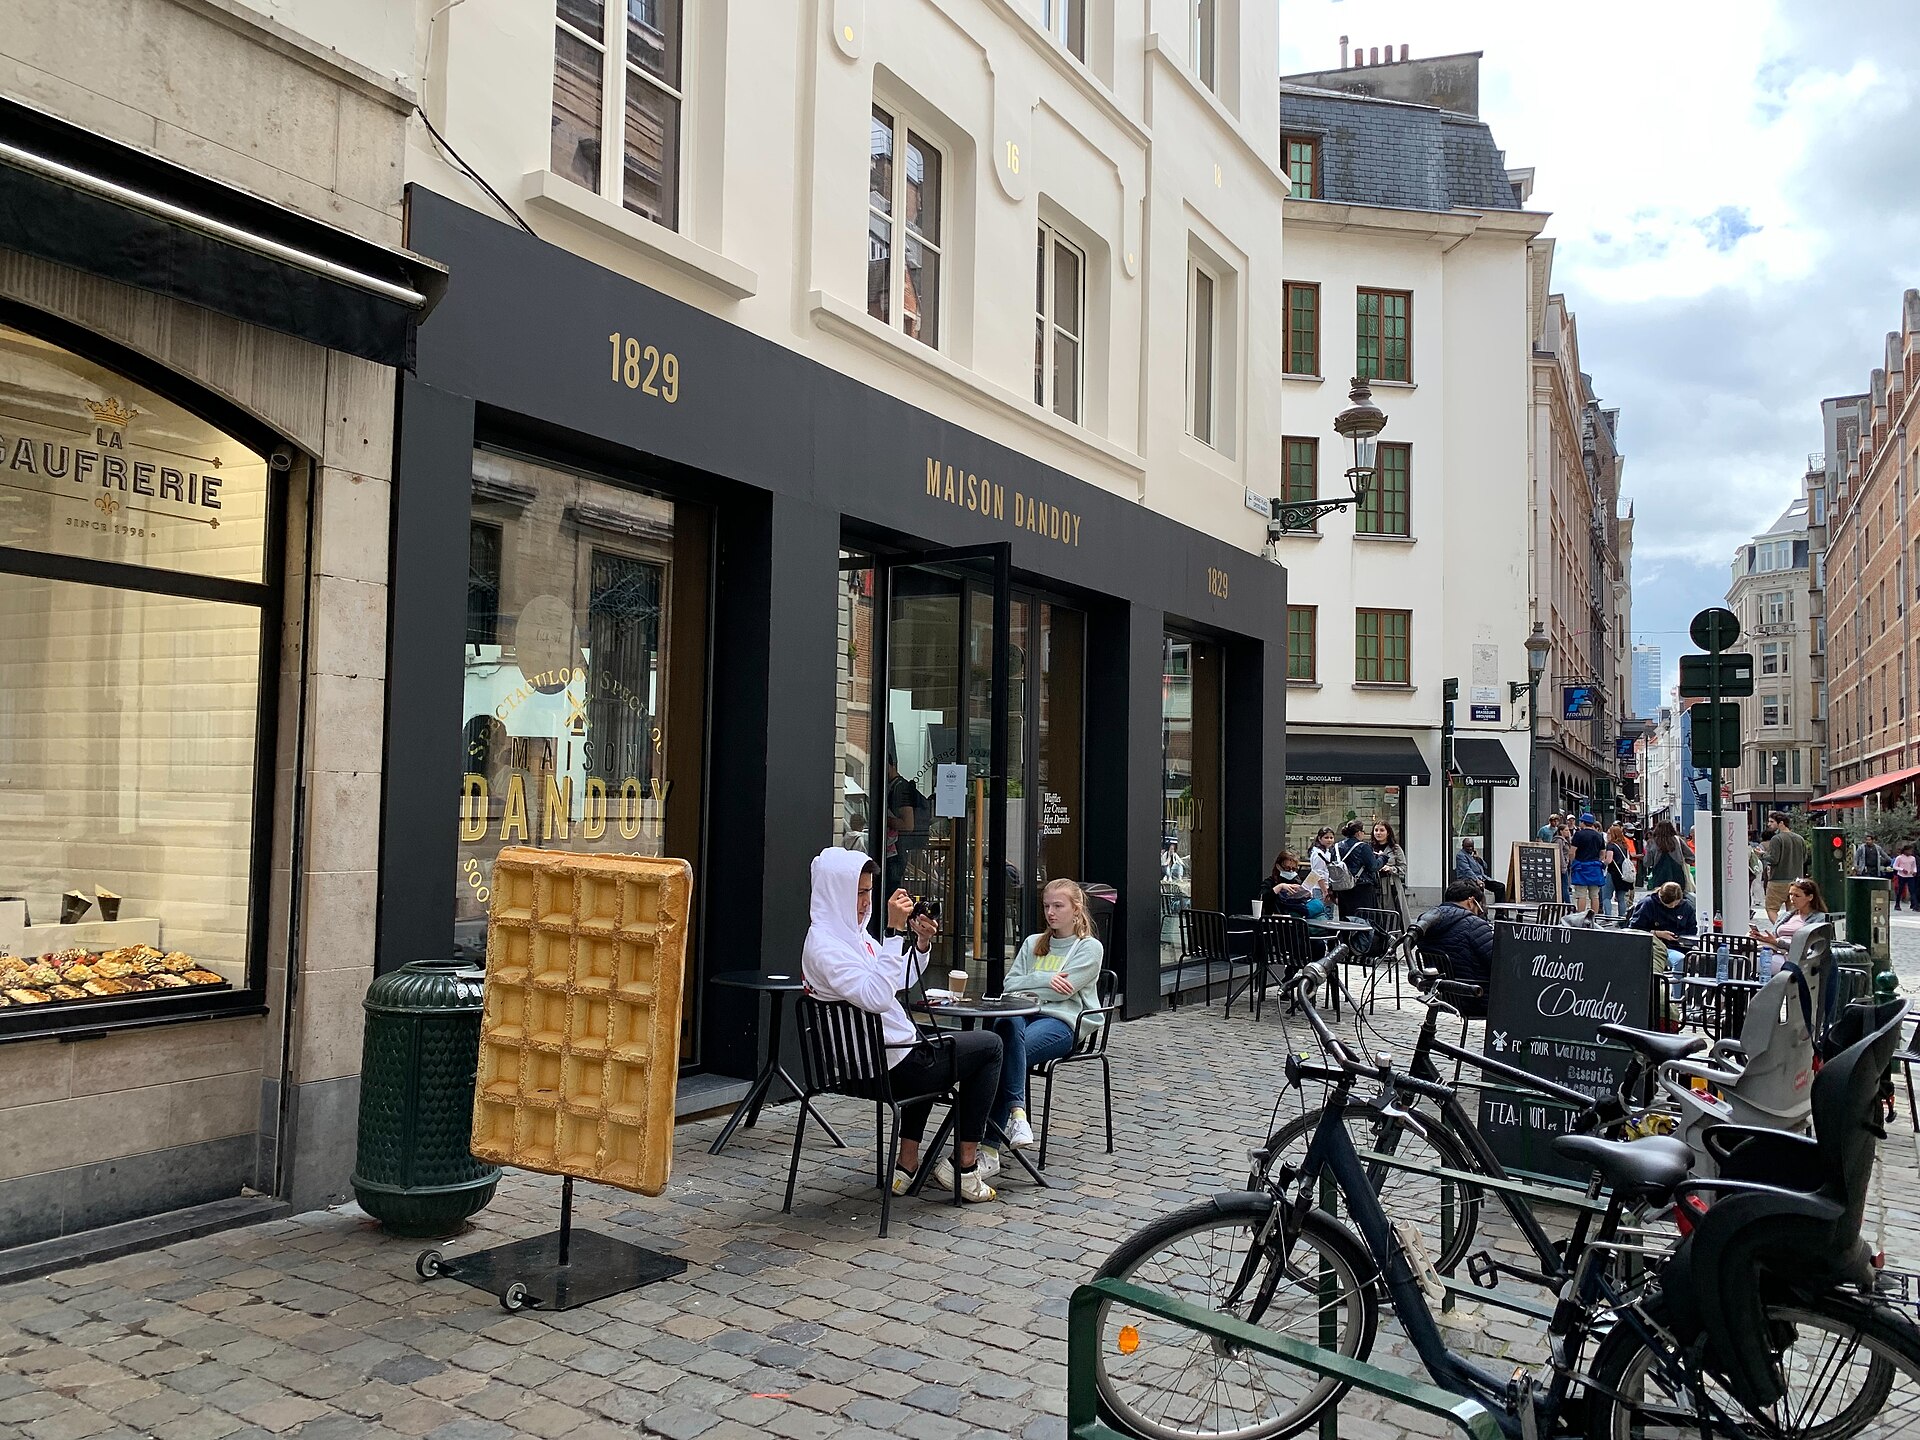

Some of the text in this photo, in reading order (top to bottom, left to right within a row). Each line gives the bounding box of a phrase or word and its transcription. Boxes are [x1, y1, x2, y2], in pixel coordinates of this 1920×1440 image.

[1006, 140, 1020, 175] 16
[1213, 163, 1223, 189] 18
[608, 332, 679, 403] 1829
[96, 427, 124, 450] LA
[0, 433, 223, 510] AUFRERIE
[926, 456, 1081, 547] MAISON DANDOY
[65, 517, 145, 538] SINCE 1998
[1207, 566, 1228, 600] 1829
[511, 736, 639, 775] MAISON
[461, 771, 673, 842] DANDOY
[1838, 861, 1844, 872] 1
[1512, 925, 1571, 944] WELCOME TO
[1531, 954, 1584, 982] Maison
[1537, 981, 1627, 1025] Dandoy
[1530, 1041, 1549, 1057] YOUR
[1567, 1064, 1614, 1085] Biscuits
